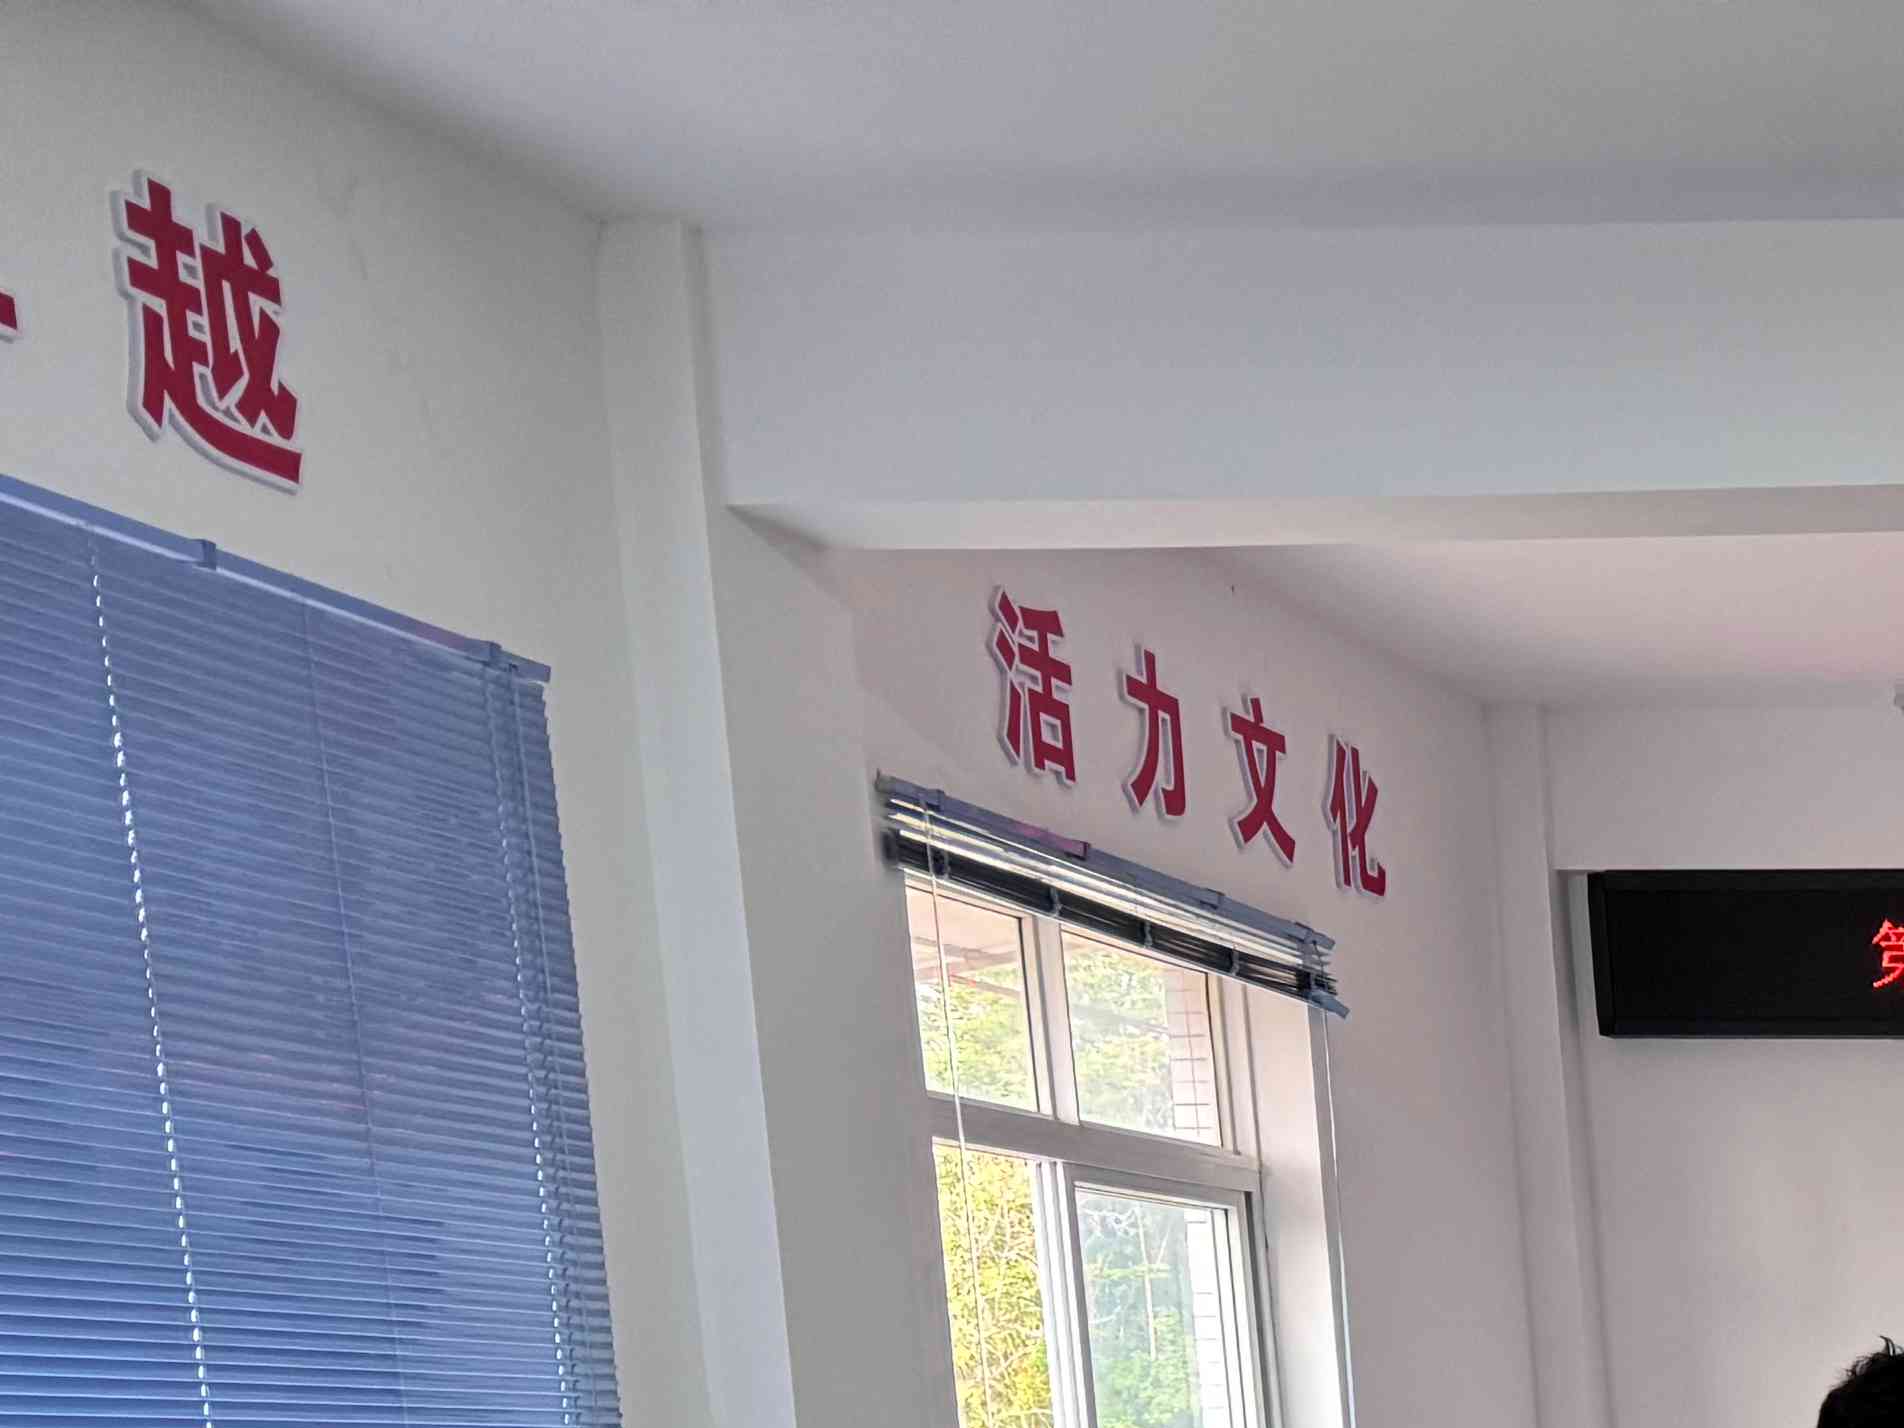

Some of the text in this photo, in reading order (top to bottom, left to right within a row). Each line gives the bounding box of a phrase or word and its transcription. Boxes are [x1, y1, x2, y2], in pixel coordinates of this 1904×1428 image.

[0, 172, 303, 490] 越
[990, 586, 1386, 898] 活力文化
